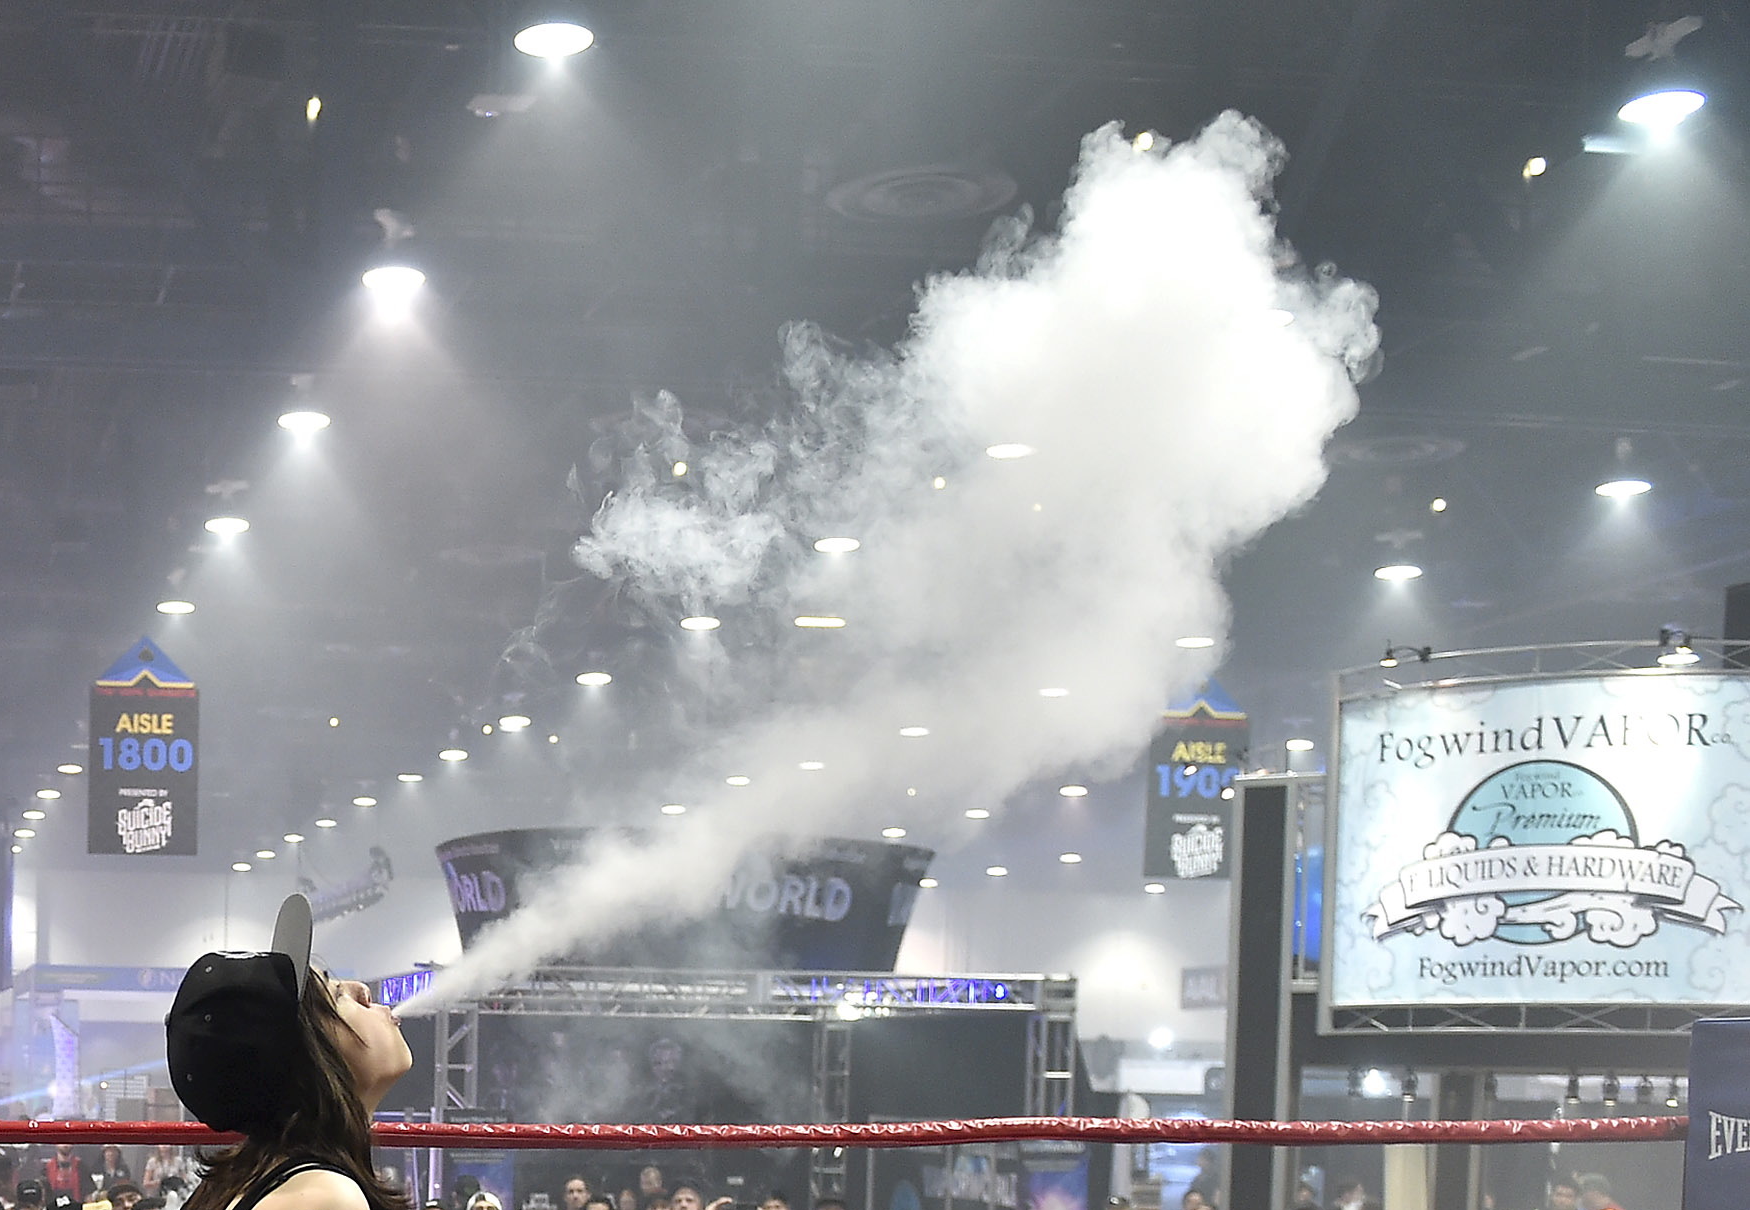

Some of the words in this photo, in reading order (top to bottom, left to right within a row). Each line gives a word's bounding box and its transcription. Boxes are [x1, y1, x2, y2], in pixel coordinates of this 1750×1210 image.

[116, 713, 174, 734] AISLE
[99, 737, 194, 773] 1800
[1171, 741, 1226, 764] AISLE
[1500, 781, 1573, 800] VAPOR
[117, 802, 173, 836] SUICIDE
[1471, 801, 1602, 836] Premium
[121, 823, 172, 852] BUNNY
[1428, 855, 1519, 889] LIQUIDS
[1522, 853, 1540, 876] &
[1547, 854, 1686, 890] HARDWARE
[1419, 954, 1671, 984] FogwindVapor.com
[1708, 1111, 1750, 1160] EVE
